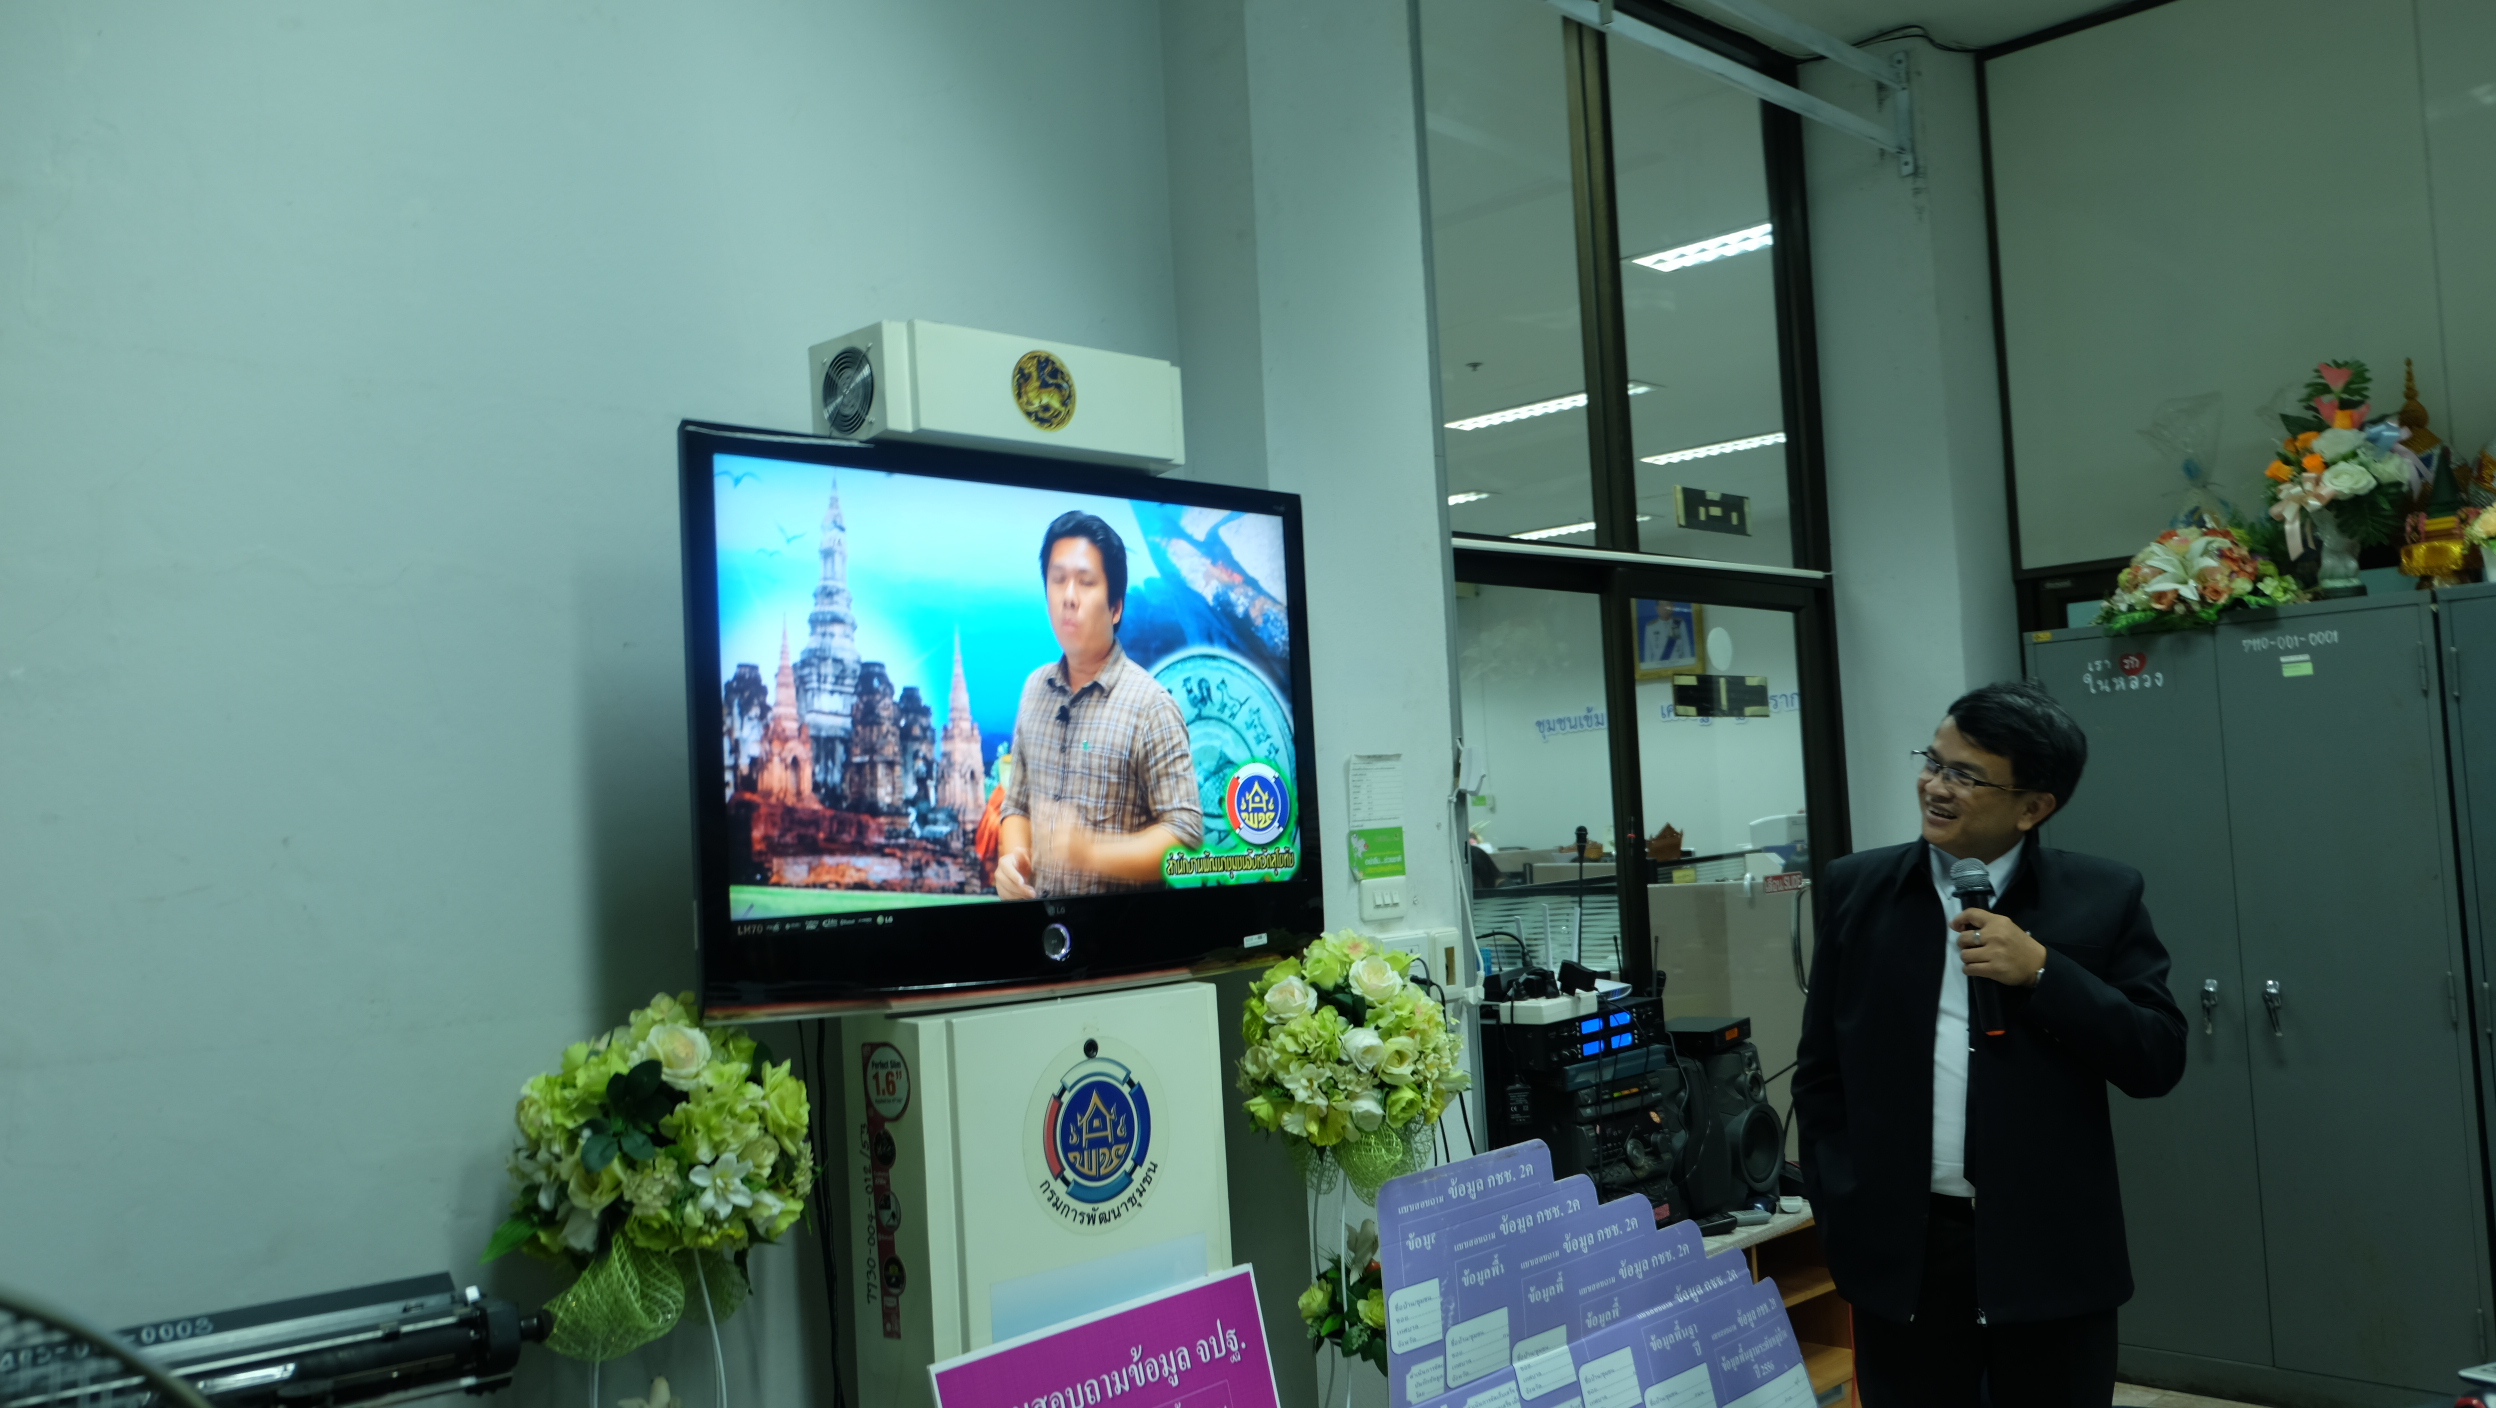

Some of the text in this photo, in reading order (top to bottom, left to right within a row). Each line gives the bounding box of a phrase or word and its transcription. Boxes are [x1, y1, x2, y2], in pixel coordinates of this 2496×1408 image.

[1039, 1161, 1158, 1226] กรมการพัฒนาชุมชน
[1196, 1318, 1246, 1364] จปฐ.
